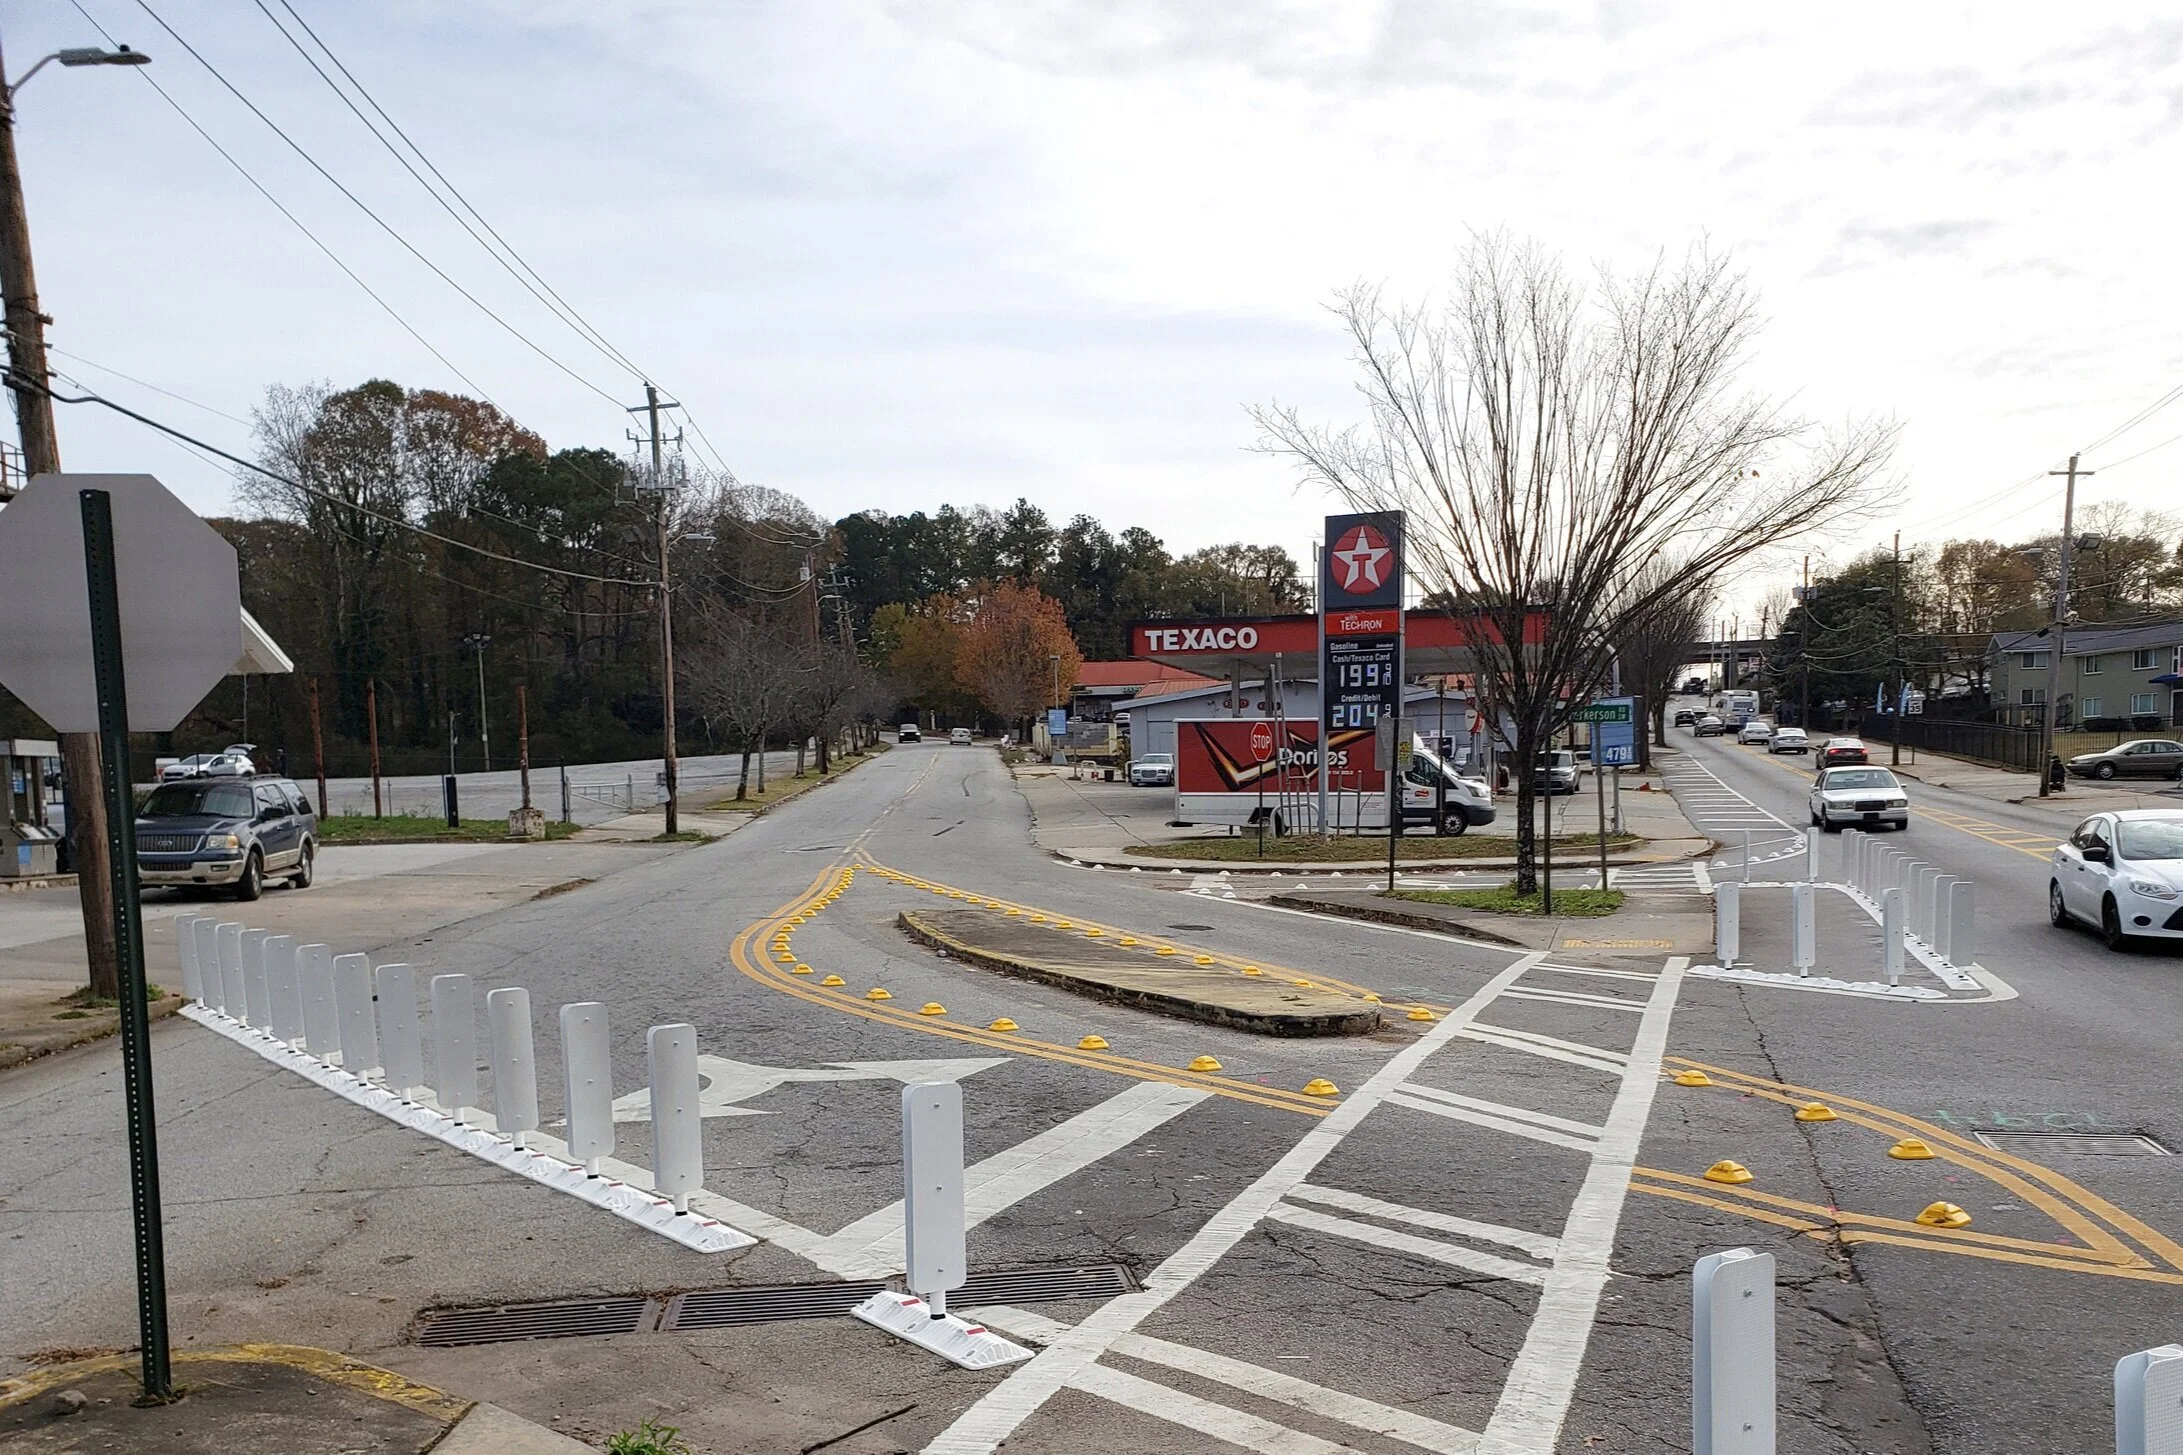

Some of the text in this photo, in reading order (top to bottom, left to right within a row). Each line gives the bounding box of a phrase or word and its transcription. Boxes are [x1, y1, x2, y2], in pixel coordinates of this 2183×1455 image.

[1340, 620, 1383, 631] TECHRON
[1144, 626, 1258, 651] TEXACO
[1330, 642, 1359, 650] Gasoline
[1375, 653, 1391, 661] Card
[1341, 694, 1381, 702] Credit/Debit
[1910, 705, 1921, 713] 35
[1252, 734, 1271, 750] STOP
[1279, 747, 1348, 766] Dorios
